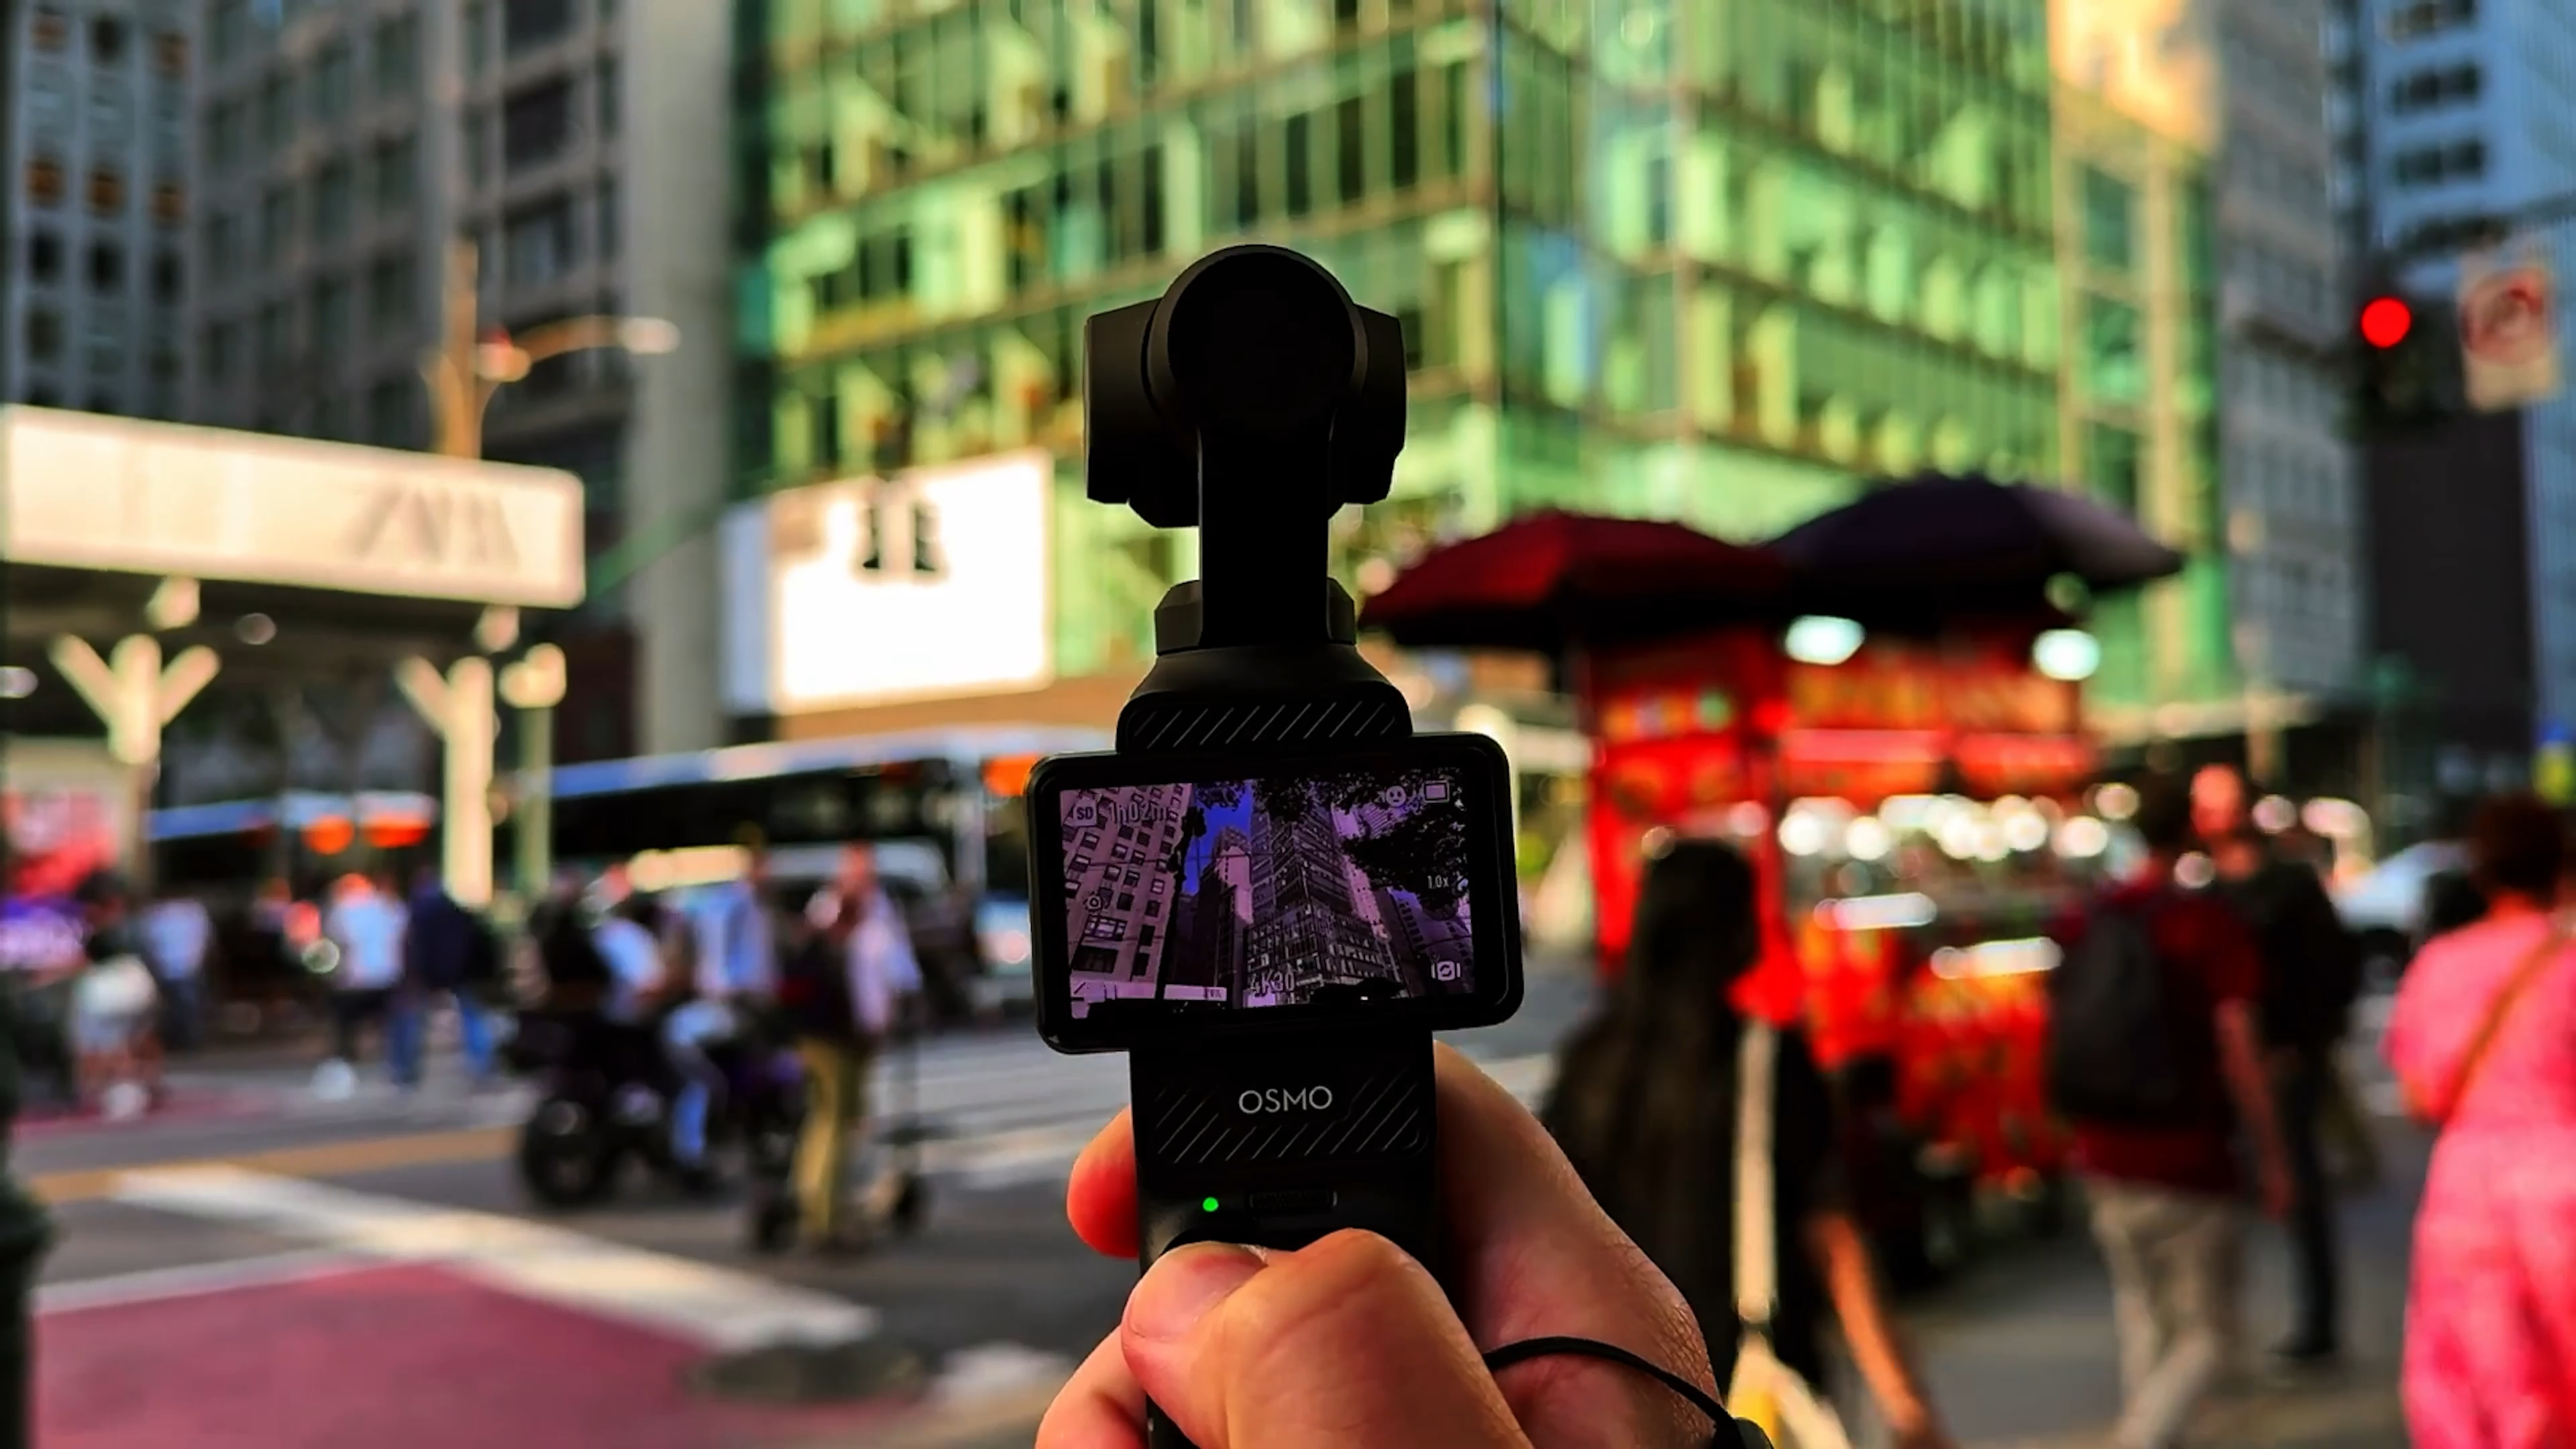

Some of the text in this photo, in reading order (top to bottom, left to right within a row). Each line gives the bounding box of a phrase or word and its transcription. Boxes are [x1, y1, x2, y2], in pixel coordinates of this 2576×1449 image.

[1076, 806, 1094, 820] SD
[1249, 969, 1295, 995] 4K30
[1238, 1085, 1333, 1114] OSMO
